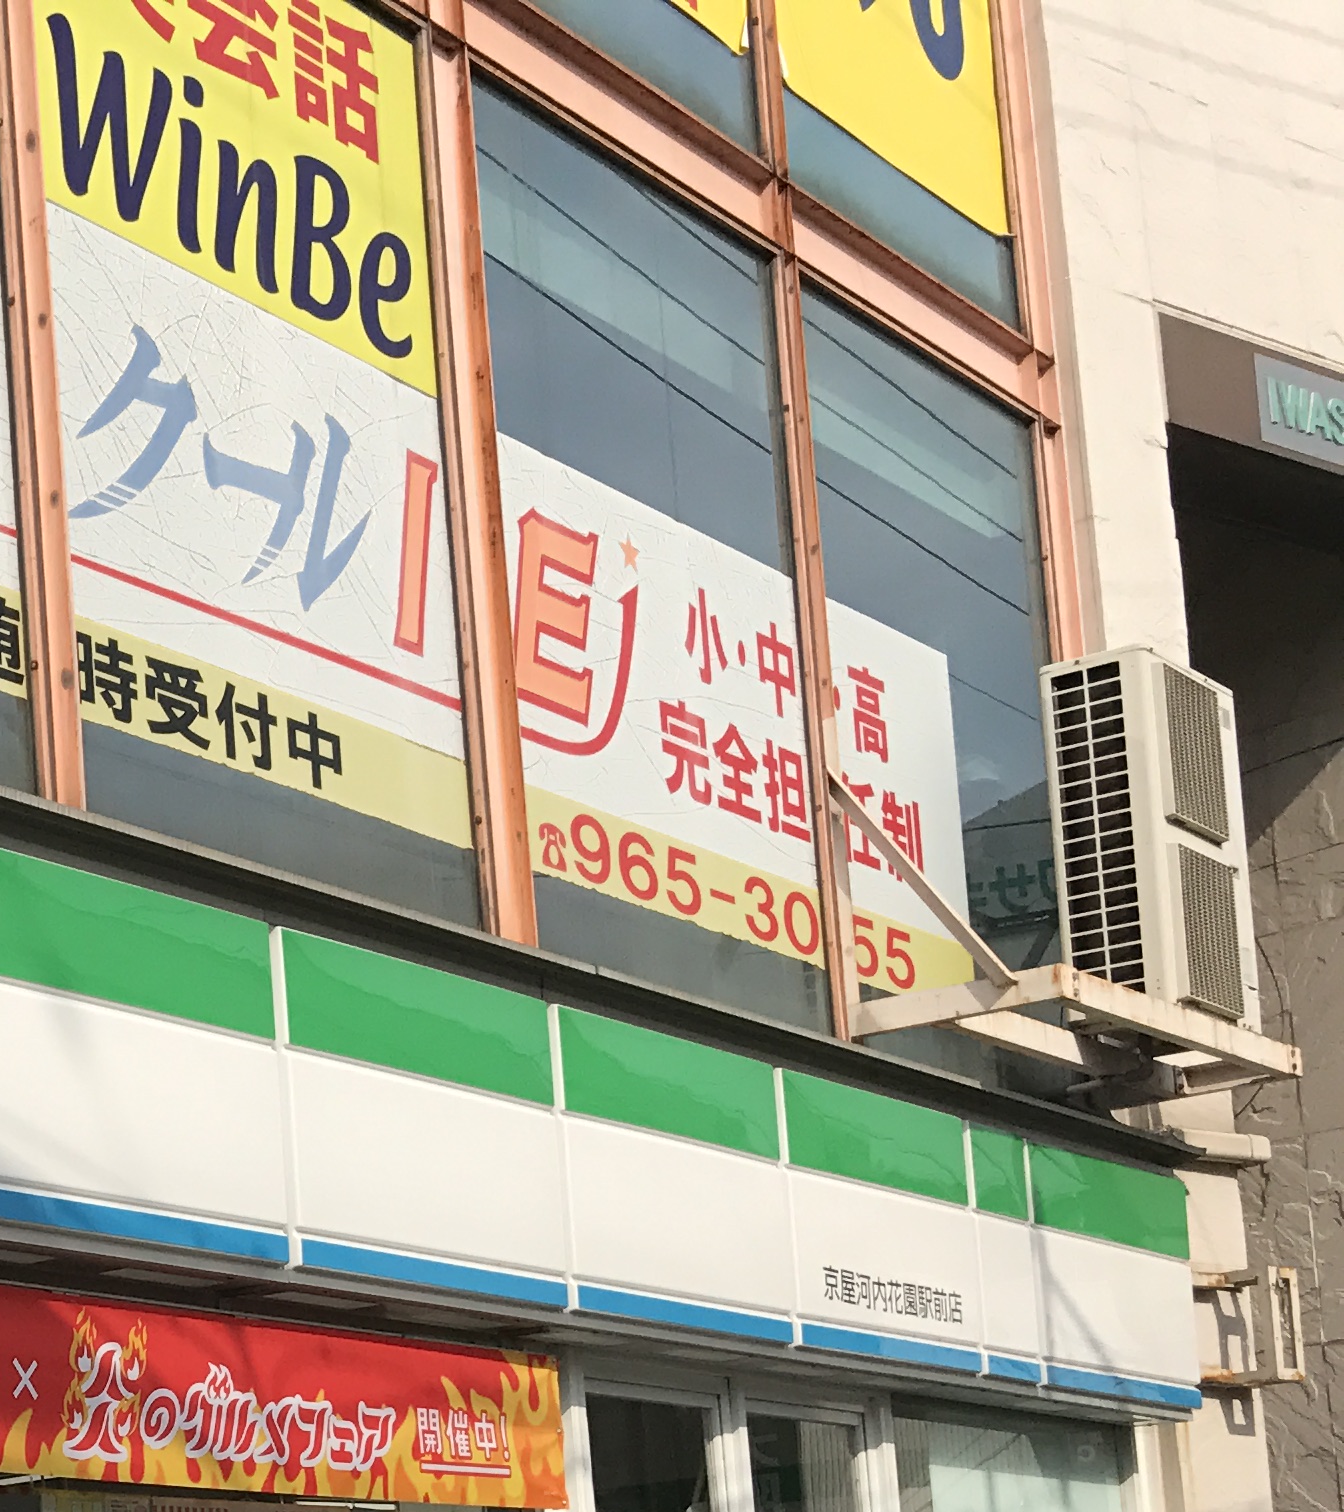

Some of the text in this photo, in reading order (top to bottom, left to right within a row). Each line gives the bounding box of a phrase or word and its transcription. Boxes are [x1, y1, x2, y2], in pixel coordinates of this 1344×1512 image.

[134, 0, 380, 164] 会話
[46, 12, 412, 359] WinBe
[822, 1265, 963, 1324] 京屋河内花園駅前店
[63, 1343, 396, 1472] 炎のグルメフェア
